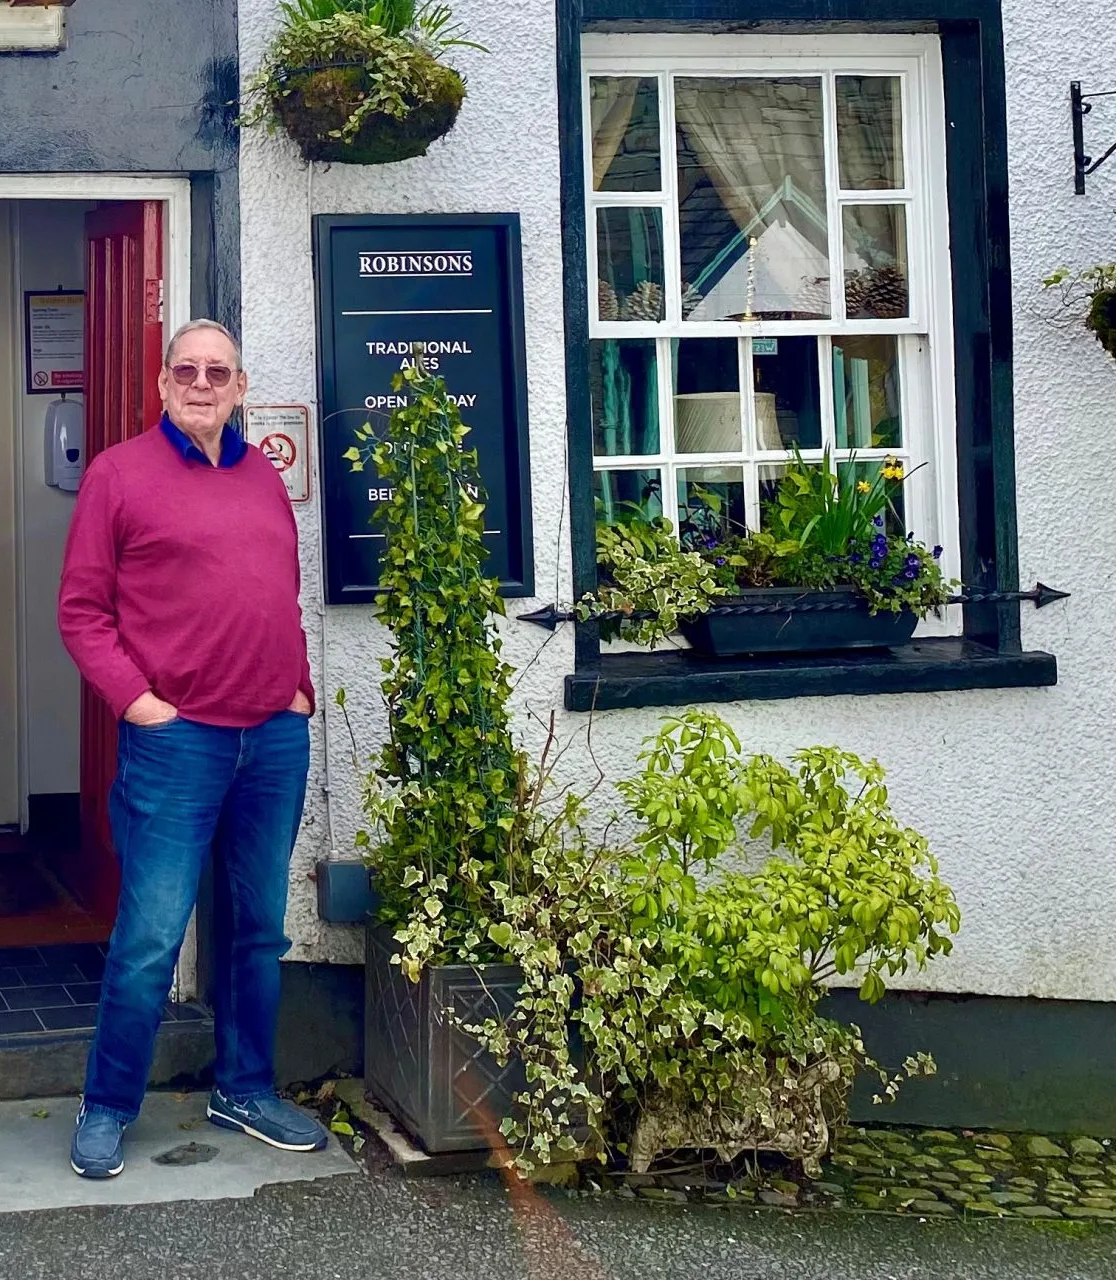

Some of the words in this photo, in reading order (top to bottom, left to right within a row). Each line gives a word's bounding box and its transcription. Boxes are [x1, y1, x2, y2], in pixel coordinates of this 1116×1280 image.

[359, 255, 473, 273] ROBINSONS
[365, 341, 472, 355] TRADIIONAL
[364, 395, 408, 409] OPEN
